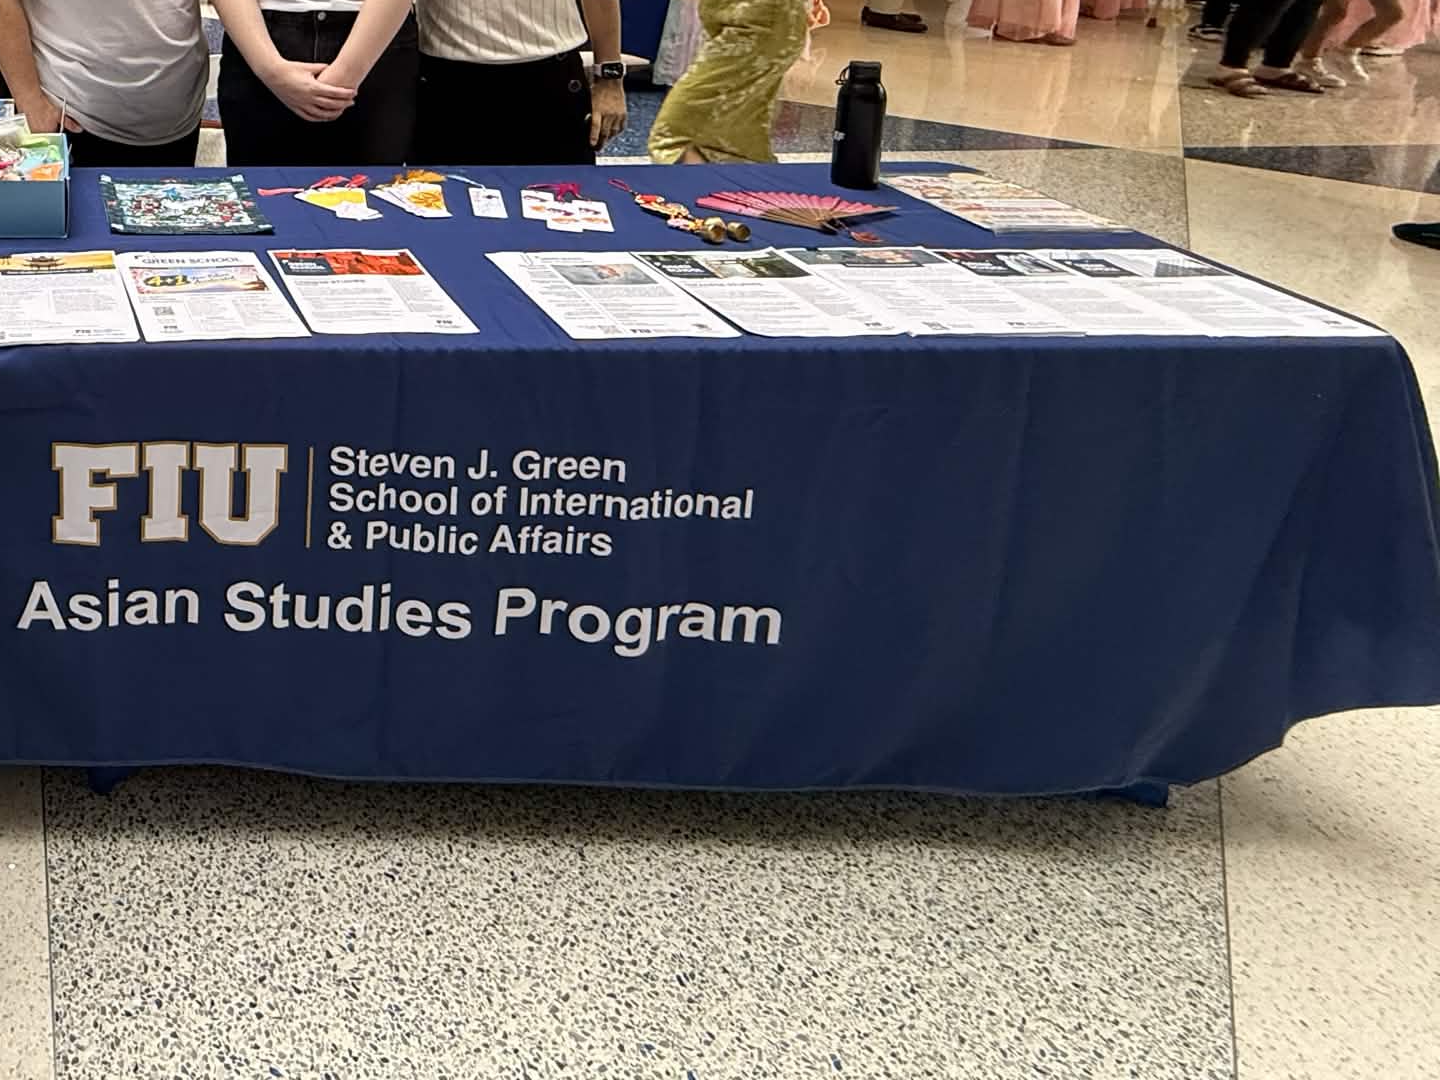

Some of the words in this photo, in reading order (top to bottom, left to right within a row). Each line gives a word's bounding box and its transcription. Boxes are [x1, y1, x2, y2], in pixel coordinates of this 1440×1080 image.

[51, 440, 289, 547] FIU
[328, 445, 457, 480] Steven
[467, 450, 498, 481] J.
[512, 450, 627, 482] Green
[327, 481, 460, 517] School
[471, 485, 508, 517] of
[519, 487, 755, 521] International
[327, 523, 353, 551] &
[365, 520, 482, 556] Public
[489, 522, 614, 558] Affairs
[17, 578, 201, 633] Asian
[224, 581, 473, 640] Studies
[494, 586, 784, 659] Program
